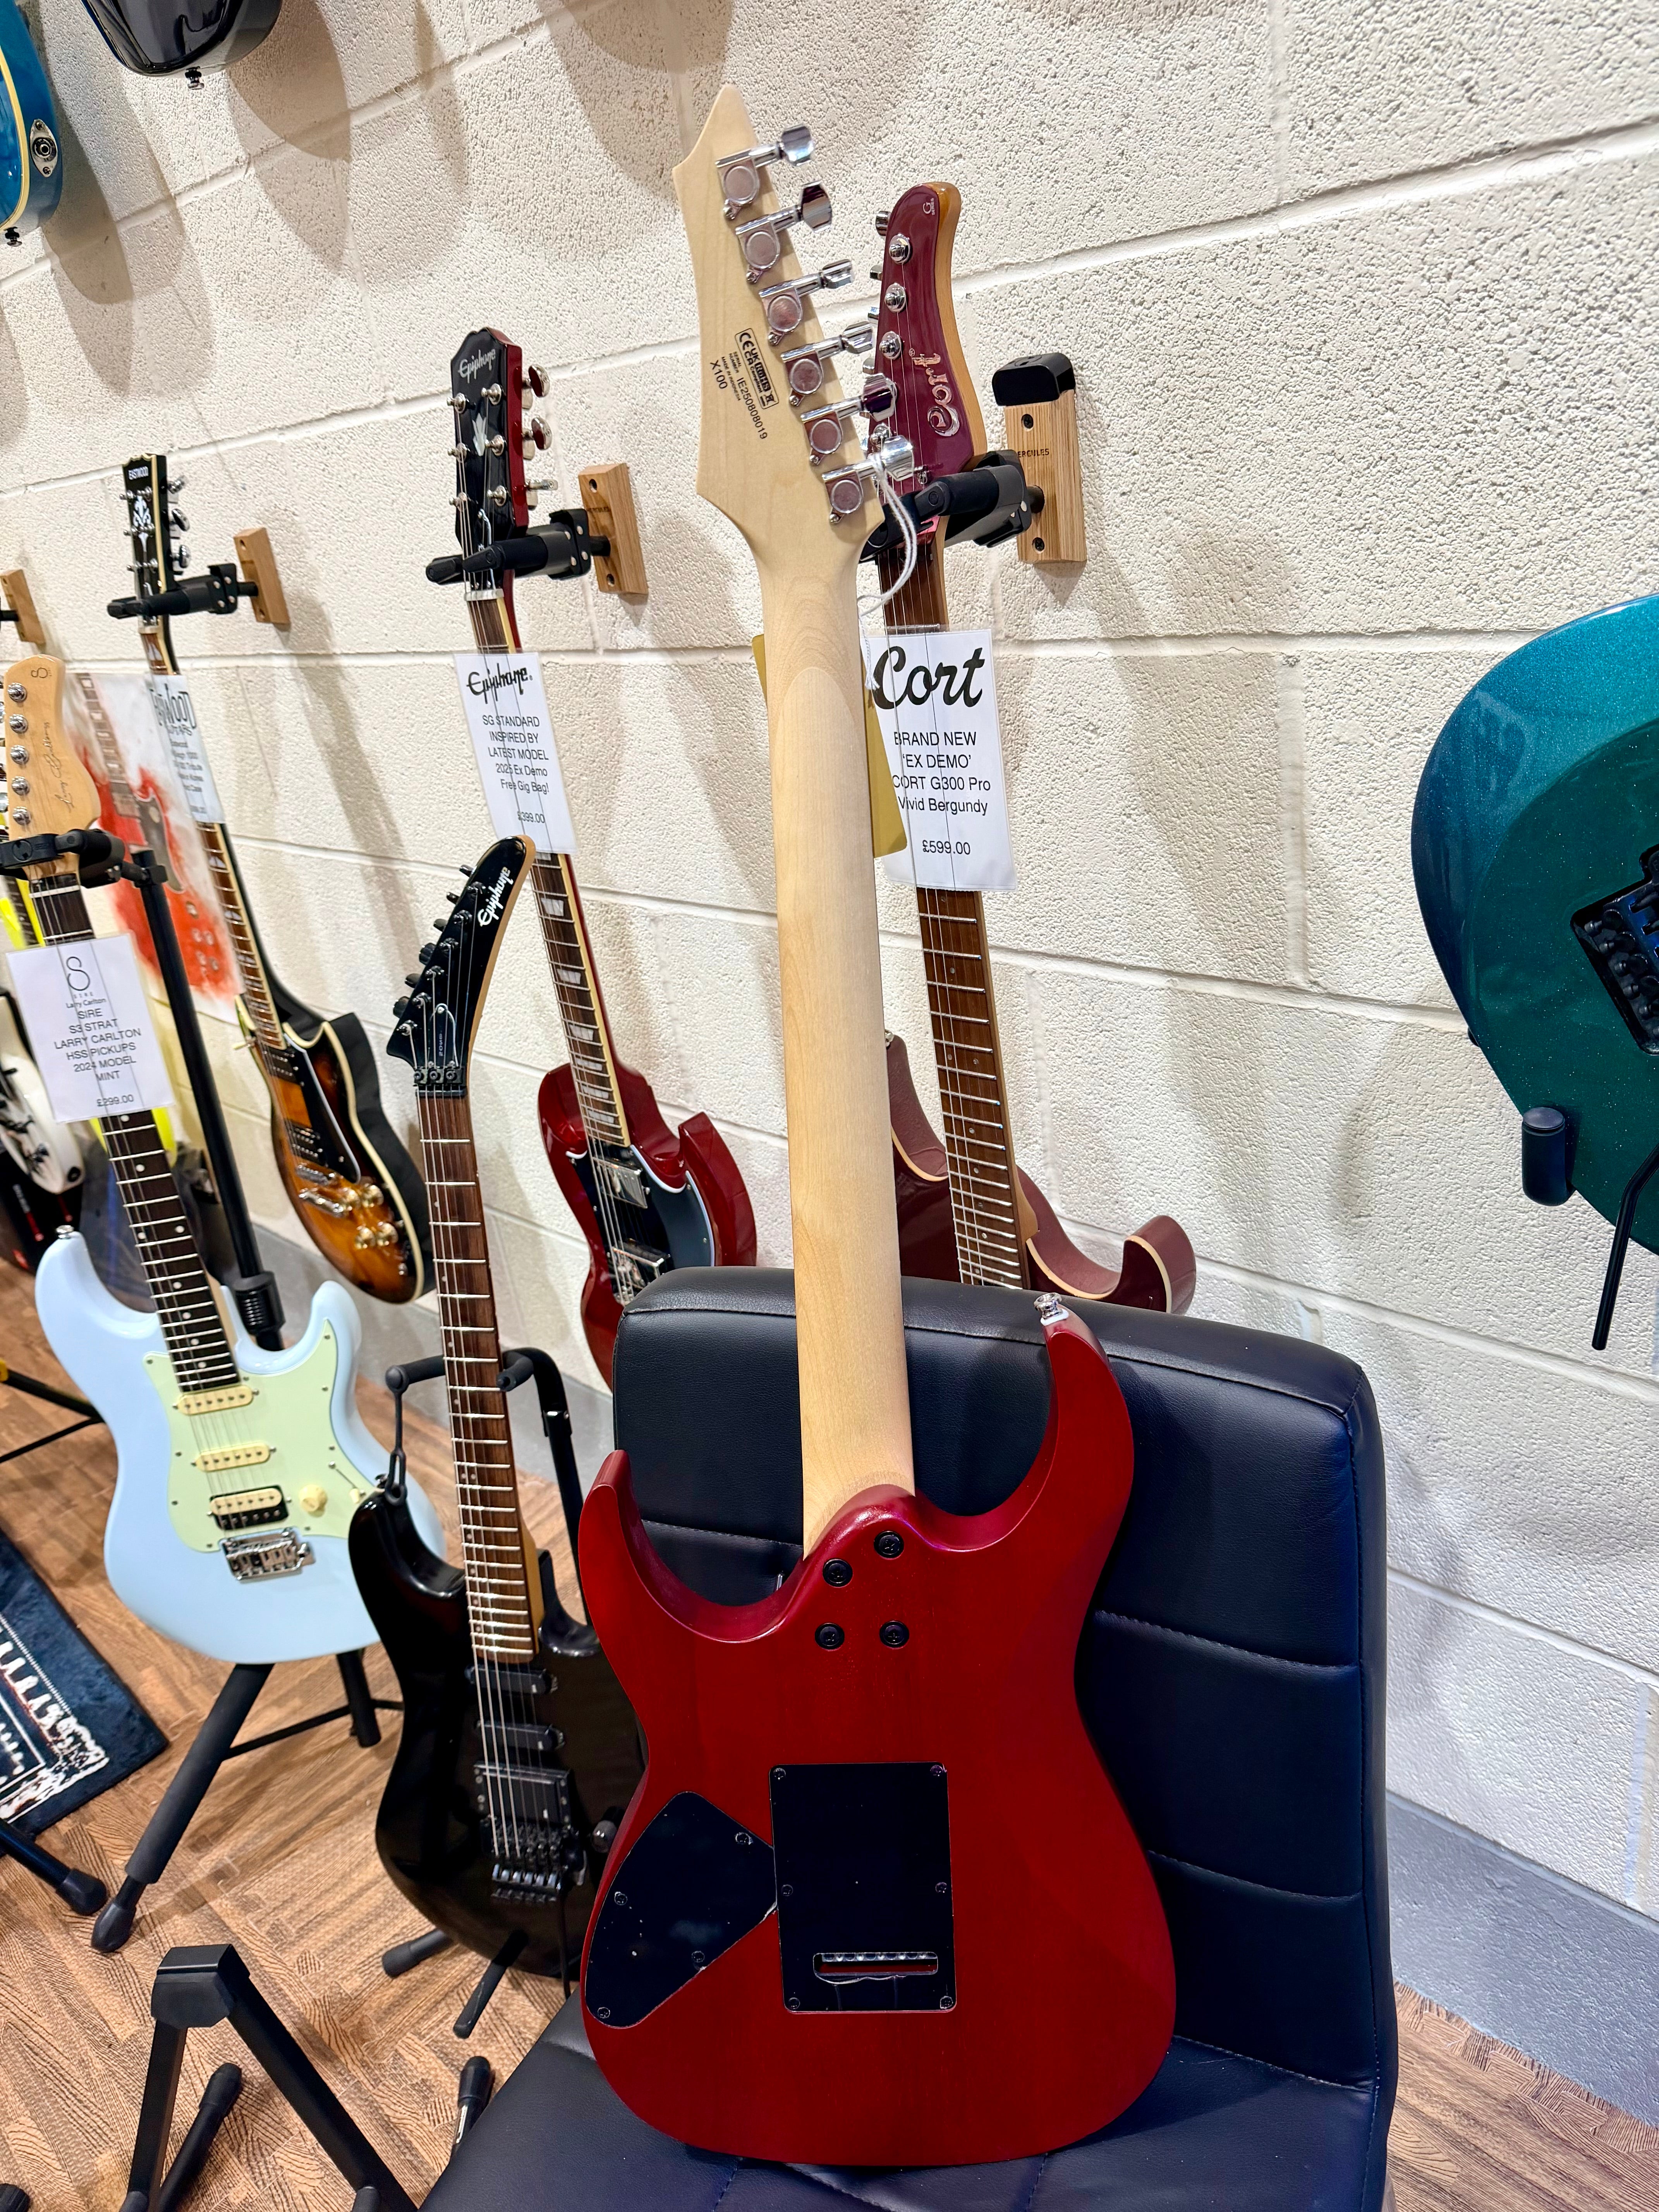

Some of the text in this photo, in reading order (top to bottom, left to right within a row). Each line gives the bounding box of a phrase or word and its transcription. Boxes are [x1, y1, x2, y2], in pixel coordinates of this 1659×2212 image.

[744, 351, 754, 365] CA
[750, 348, 760, 362] UK
[458, 349, 496, 384] Epiphone
[710, 360, 728, 389] X100
[912, 353, 960, 437] Cort
[737, 377, 768, 439] IE250808019
[1017, 448, 1049, 458] ERCULES
[466, 663, 529, 704] Epiphone
[872, 646, 985, 709] Cort
[482, 715, 540, 727] SG STANDARD
[490, 731, 539, 744] INSPIRED BY
[894, 731, 977, 747] BRAND NEW
[488, 747, 549, 760] LATEST MODEL
[496, 763, 548, 777] 2025 Ex Demo
[500, 778, 549, 795] Free Gig Bag!
[892, 775, 991, 791] CORT G300 Pro
[898, 796, 988, 816] Vivid Bergundy
[922, 840, 971, 855] £599.00
[477, 866, 513, 927] Epiphone
[78, 1008, 103, 1019] SIRE
[69, 1019, 118, 1034] S3 STRAT
[54, 1028, 141, 1049] LARRY CARLTON
[67, 1042, 136, 1060] HSS PICKUPS
[74, 1055, 136, 1073] 2024 MODEL
[96, 1070, 120, 1082] MINT
[97, 1094, 134, 1107] £299.00
